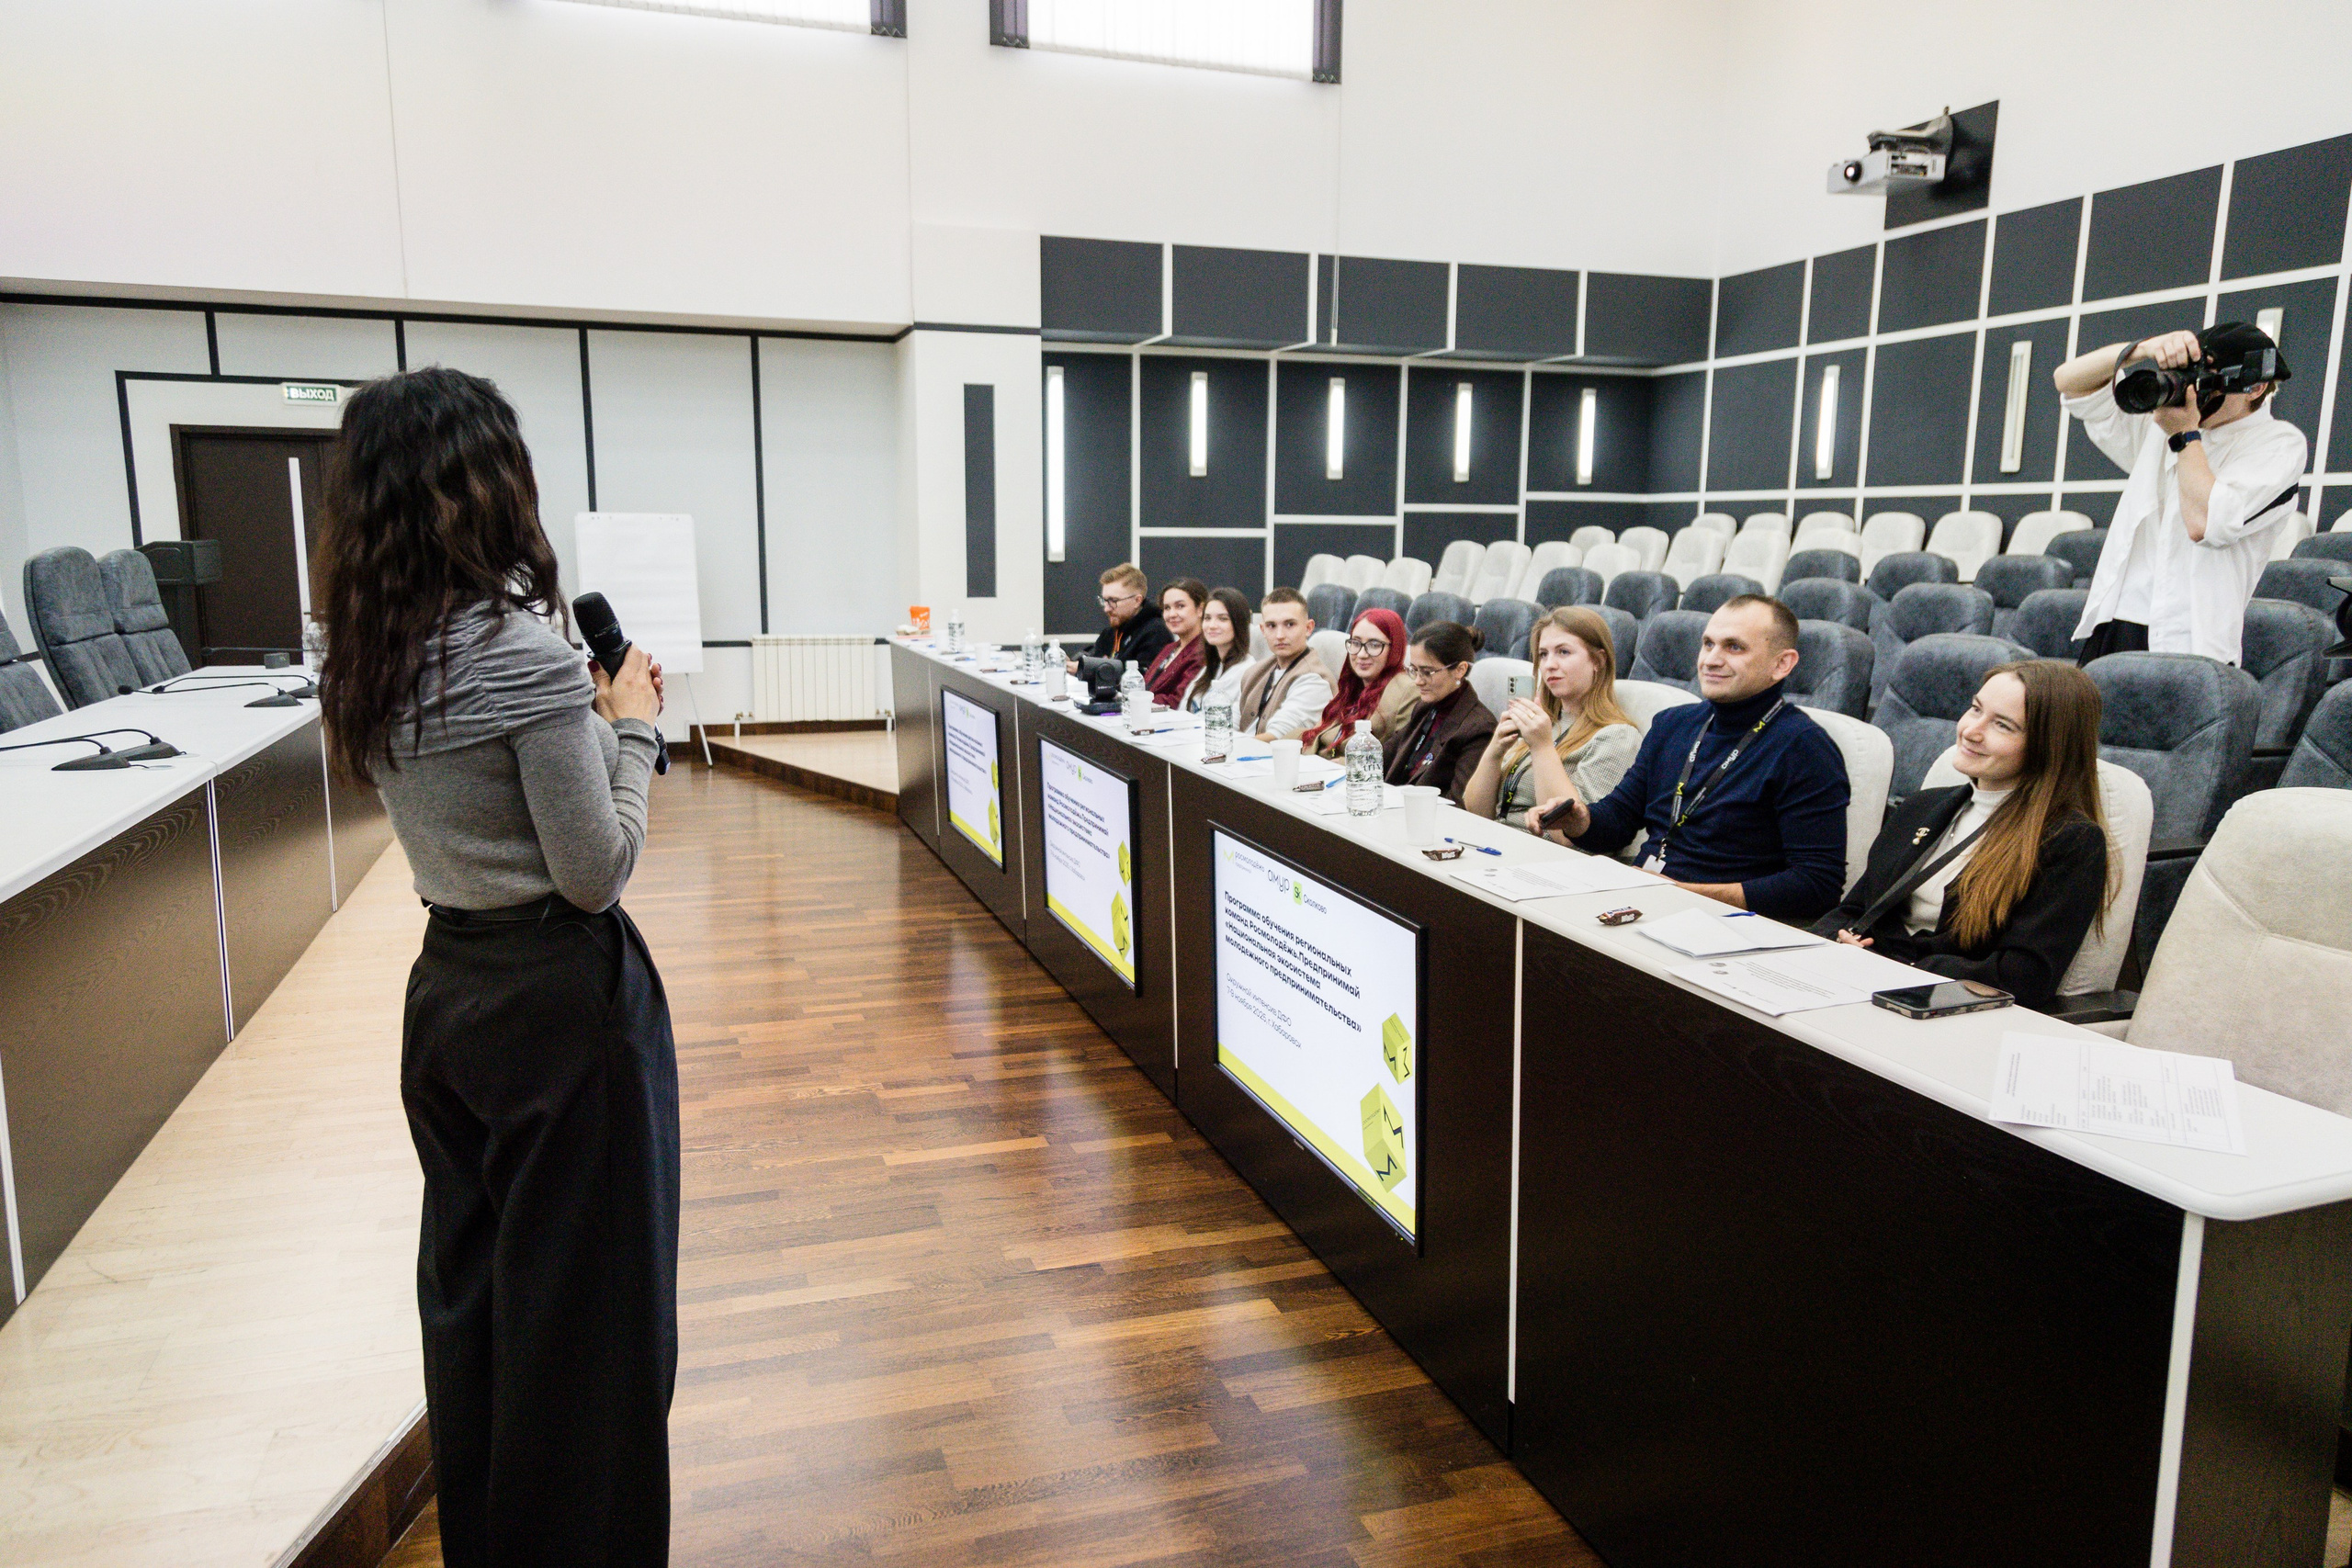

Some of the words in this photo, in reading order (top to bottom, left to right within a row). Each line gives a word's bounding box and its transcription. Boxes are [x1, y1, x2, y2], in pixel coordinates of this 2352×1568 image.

[290, 388, 334, 400] ВЫХОД
[1721, 749, 1739, 770] амур
[1268, 870, 1290, 894] амур
[1294, 886, 1302, 900] Sk
[1304, 894, 1328, 914] Сколково
[1225, 907, 1249, 929] команд
[1225, 891, 1261, 920] Программа
[1261, 915, 1294, 942] обучения
[1295, 935, 1352, 977] региональных
[1225, 920, 1276, 960] «Национальная
[1277, 953, 1321, 989] экосистема
[1225, 934, 1270, 970] молодежного
[1270, 964, 1362, 1032] предпринимательства»
[1227, 973, 1252, 997] Окружной
